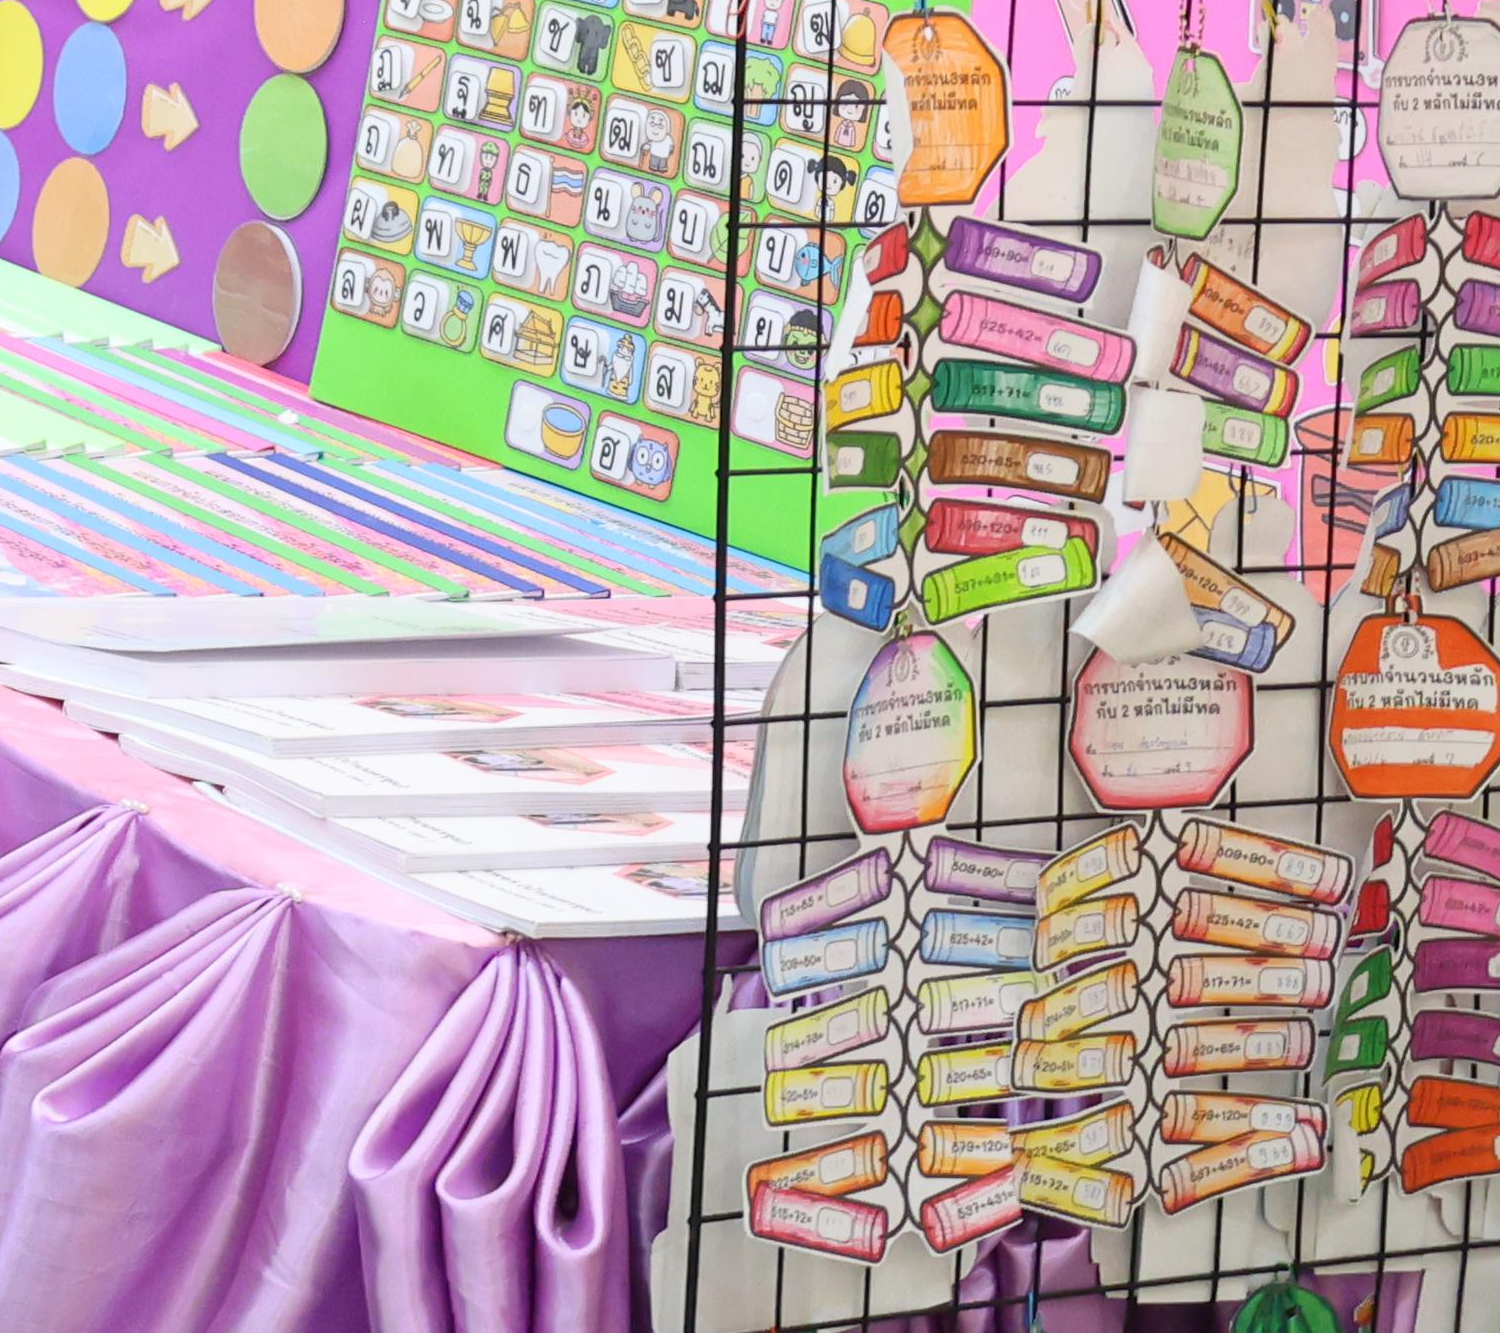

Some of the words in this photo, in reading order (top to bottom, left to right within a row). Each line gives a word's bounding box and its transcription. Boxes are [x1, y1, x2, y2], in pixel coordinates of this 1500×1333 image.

[1411, 97, 1420, 110] 2
[363, 126, 380, 159] ถ
[438, 148, 454, 179] ท
[690, 143, 717, 178] ณ
[515, 164, 531, 198] ธ
[593, 186, 611, 220] น
[678, 212, 697, 245] บ
[763, 229, 785, 273] ป
[341, 270, 358, 300] ล
[580, 264, 600, 298] ภ
[412, 294, 426, 325] ว
[663, 288, 683, 323] ม
[754, 313, 772, 348] ย
[656, 363, 674, 401] ส
[1083, 672, 1237, 695] การบวกจำนวน3หลัก
[1096, 701, 1117, 720] กับ
[1122, 704, 1130, 718] 2
[1133, 695, 1221, 717] หลักไม่มีทด
[1368, 694, 1376, 708] 2
